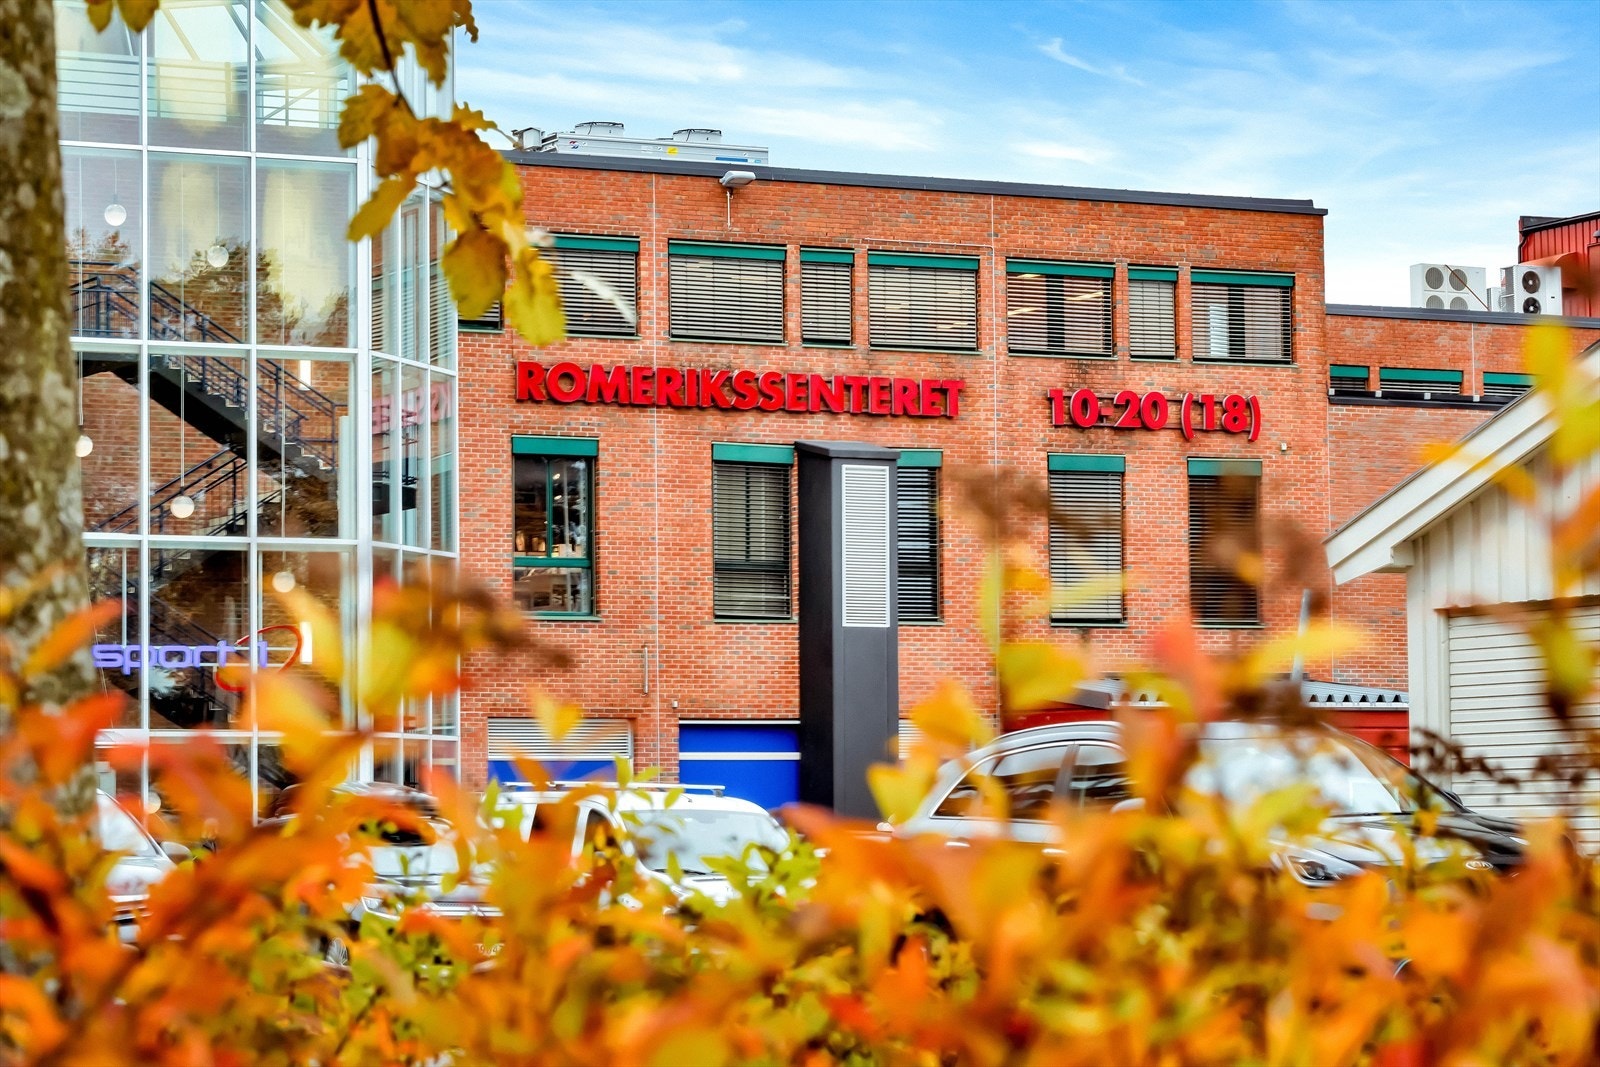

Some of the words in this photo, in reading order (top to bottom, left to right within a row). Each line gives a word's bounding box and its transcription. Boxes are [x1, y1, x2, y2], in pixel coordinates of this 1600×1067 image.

[516, 360, 966, 417] ROMERIKSSENTERET
[1047, 388, 1169, 430] 10-20
[1181, 391, 1262, 442] (18)
